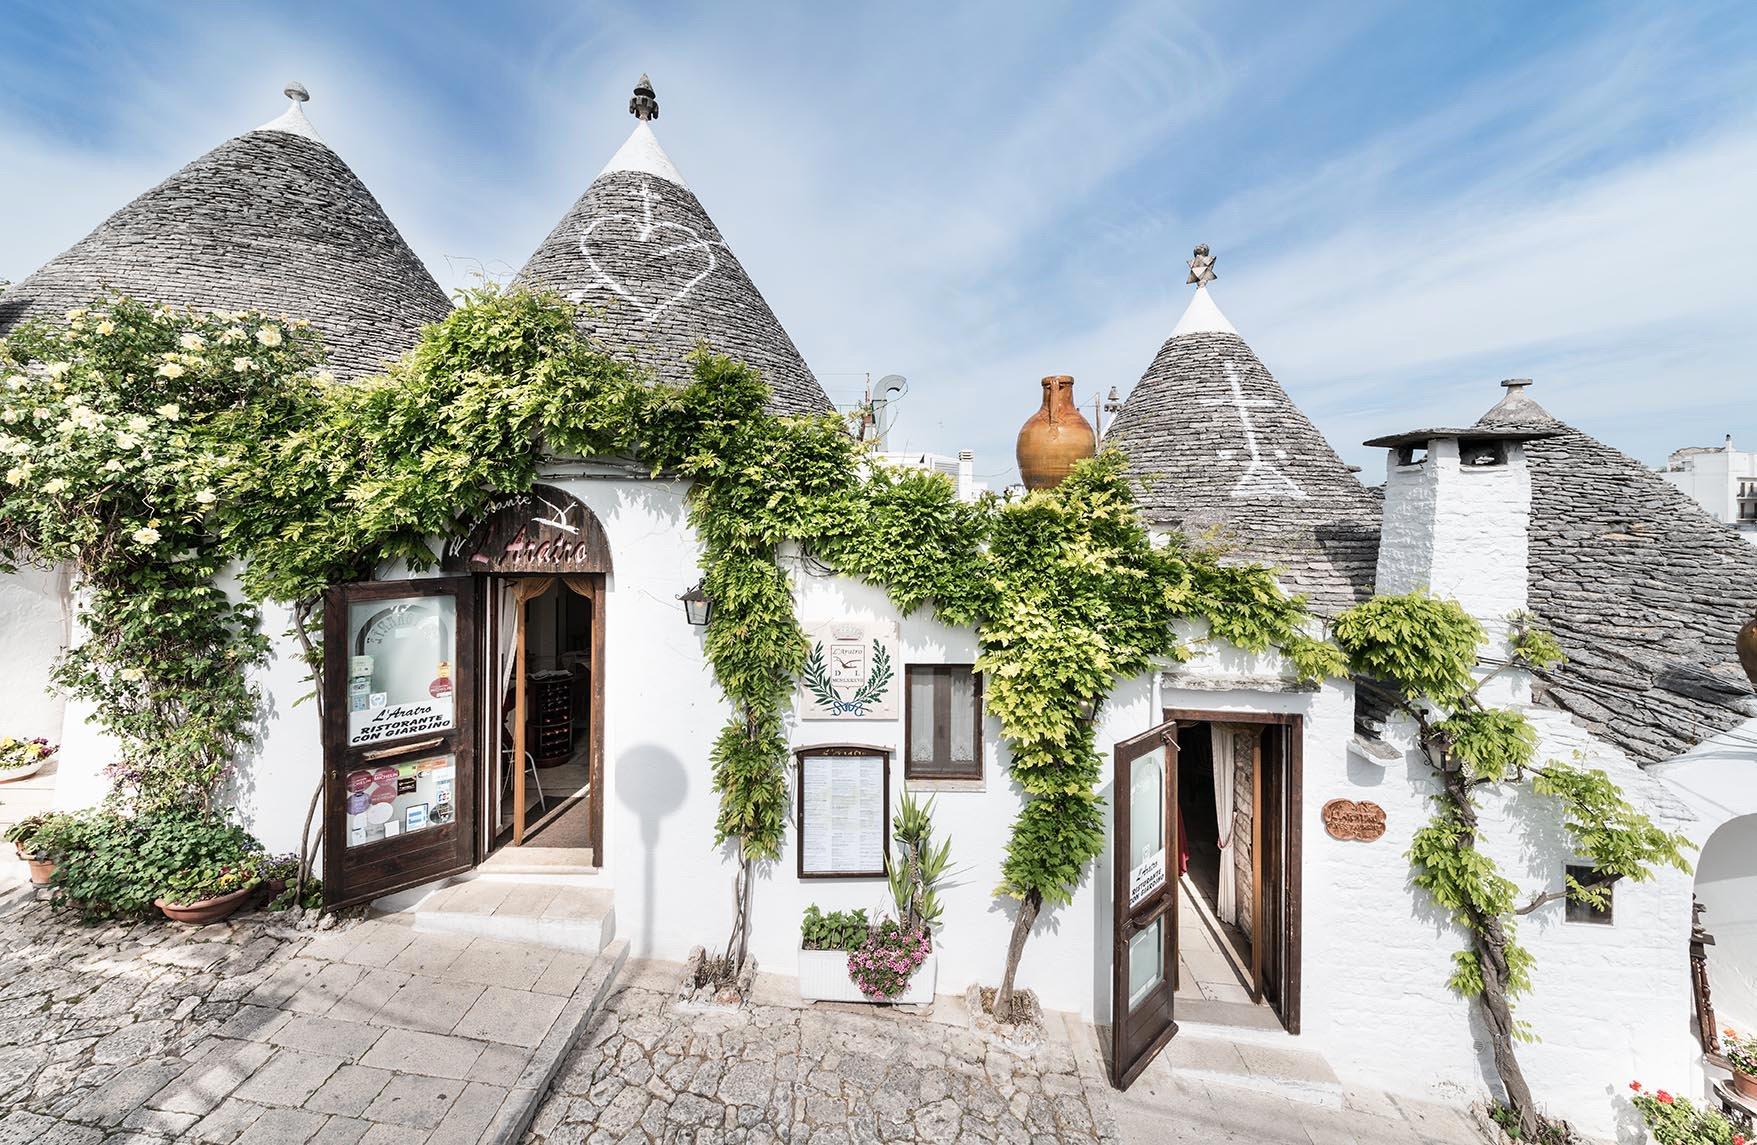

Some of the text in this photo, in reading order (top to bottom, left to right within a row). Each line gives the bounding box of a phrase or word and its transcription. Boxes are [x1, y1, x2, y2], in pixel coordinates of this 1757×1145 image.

[832, 648, 863, 656] L'Aratro
[834, 669, 842, 677] D
[360, 714, 444, 735] RISTORANTE
[372, 706, 432, 722] L'Aratro
[351, 720, 451, 743] CON GIARDINO
[1131, 868, 1162, 896] RISTORANTE
[1136, 861, 1158, 882] L'Aratro
[1140, 873, 1164, 896] GIARDINO
